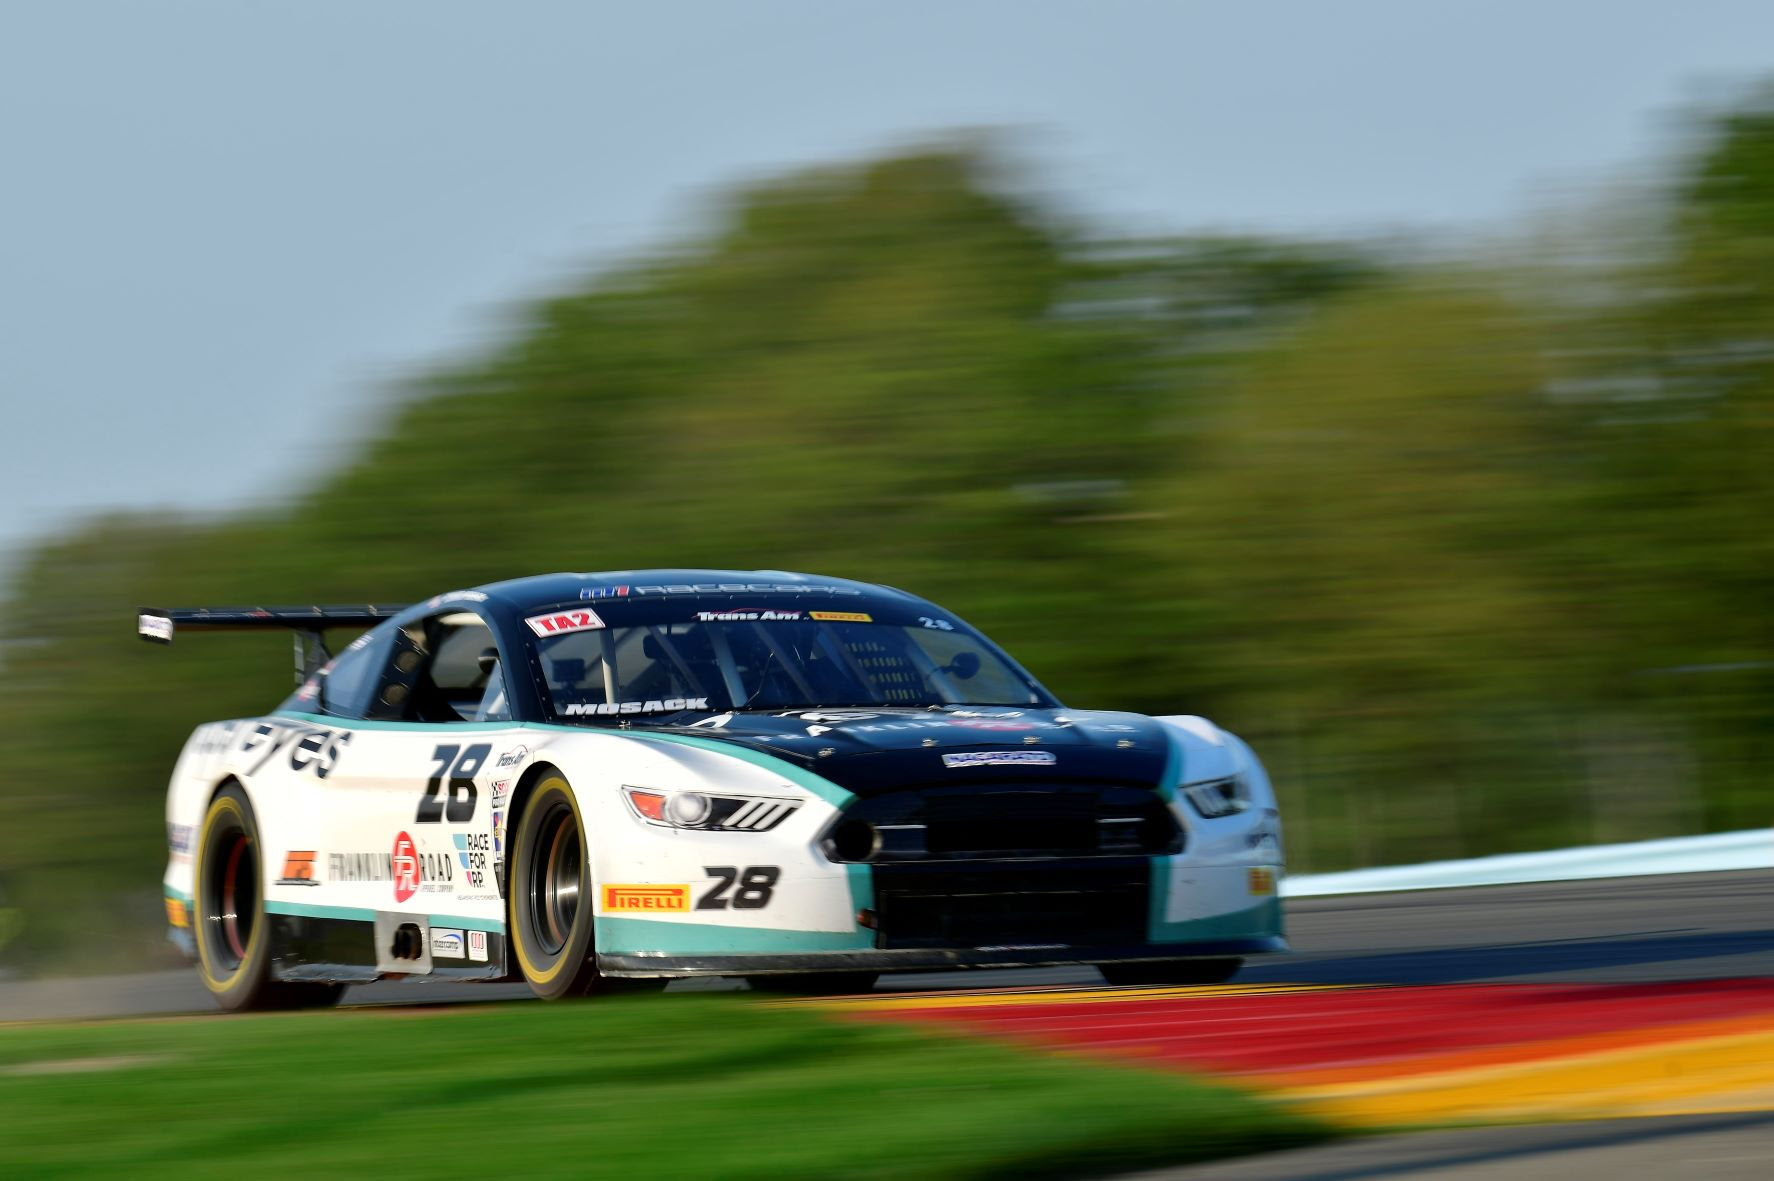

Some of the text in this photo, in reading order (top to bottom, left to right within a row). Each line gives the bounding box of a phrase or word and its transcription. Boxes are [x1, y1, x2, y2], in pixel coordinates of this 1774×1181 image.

[536, 612, 596, 632] TA2
[699, 611, 758, 621] Trans
[761, 611, 799, 621] Am
[565, 698, 708, 715] MOSACK
[414, 743, 492, 823] 28
[467, 833, 488, 851] RACE
[419, 853, 453, 881] ROAD
[469, 852, 486, 870] FOR
[607, 888, 684, 909] PIRELLI
[694, 866, 781, 911] 28
